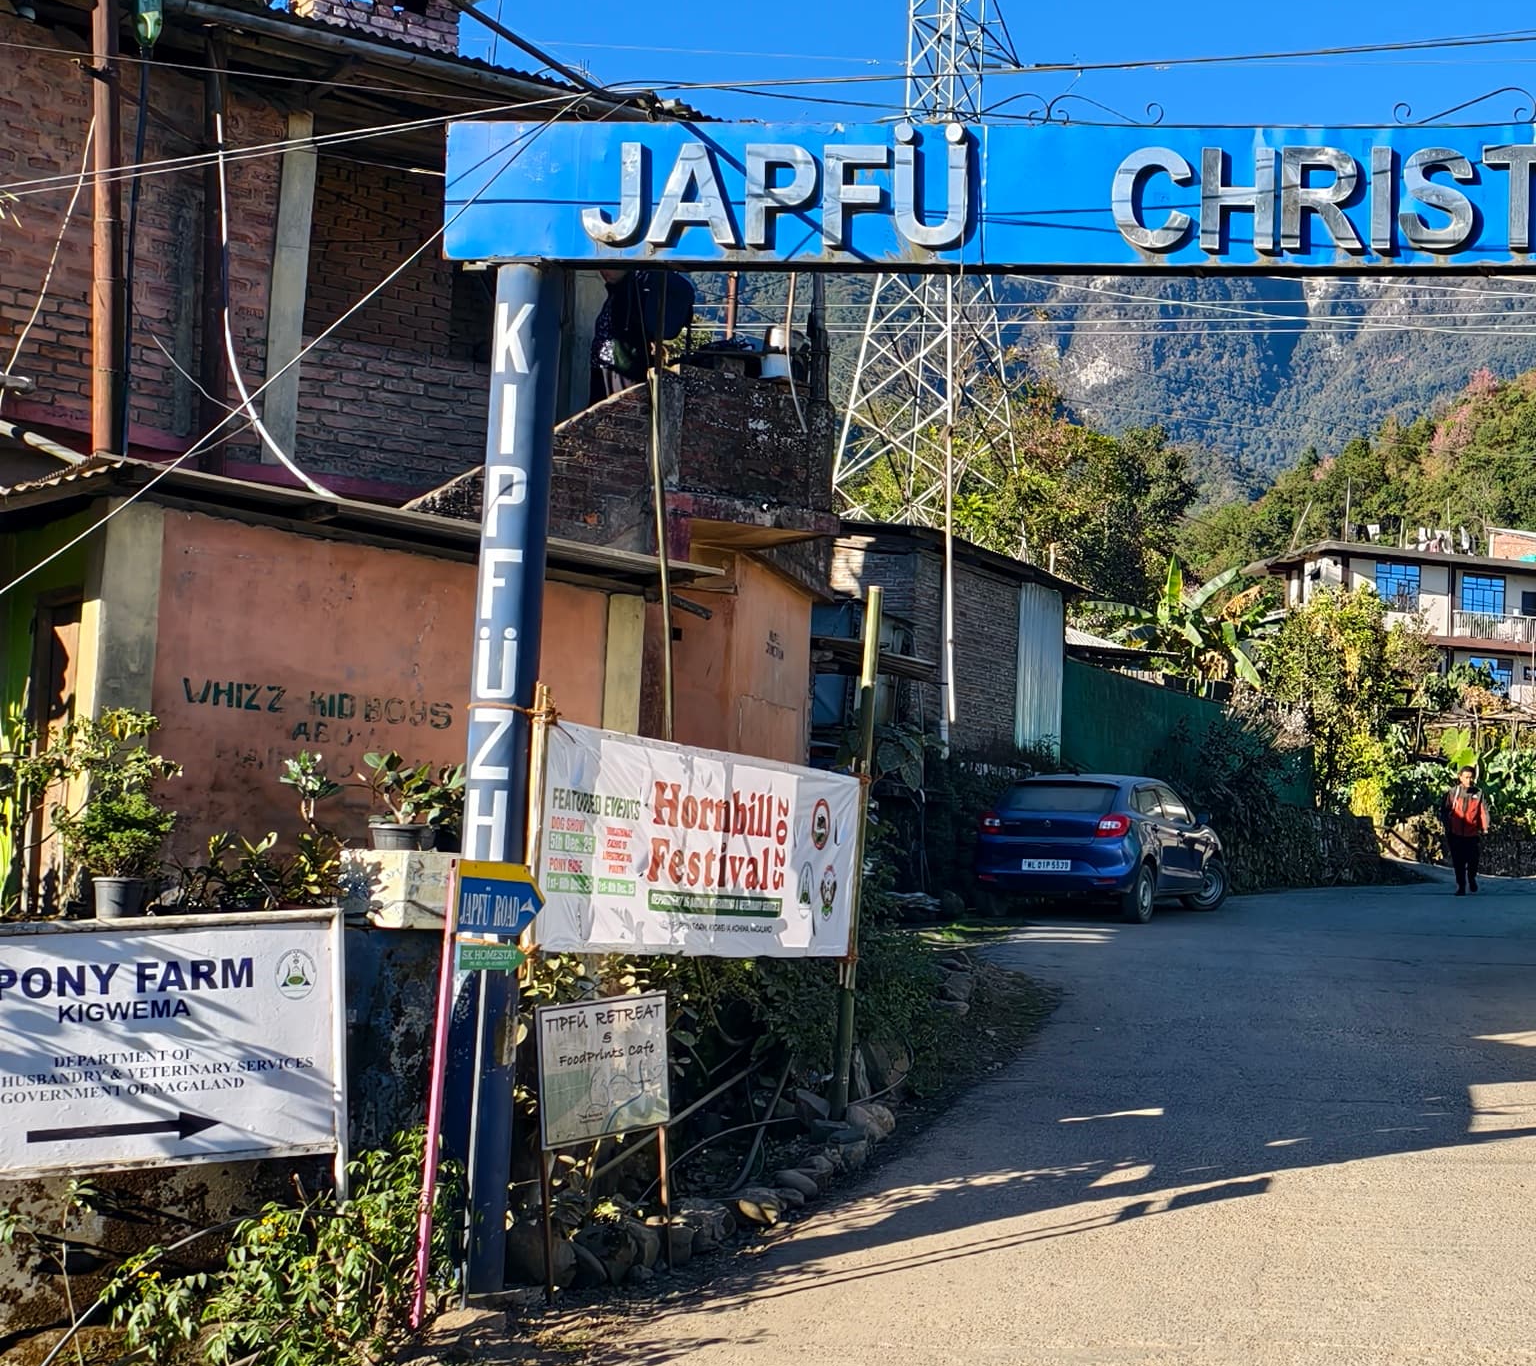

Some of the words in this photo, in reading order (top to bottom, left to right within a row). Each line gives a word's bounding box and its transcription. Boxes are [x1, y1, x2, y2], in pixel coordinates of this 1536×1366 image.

[581, 122, 969, 248] JAPFÜ
[461, 302, 535, 943] KIPFÜZH
[182, 677, 287, 713] WHIZZ
[308, 690, 357, 720] KID
[552, 787, 602, 816] FEATURED
[604, 791, 641, 822] EVENTS
[652, 780, 773, 838] Hornbill
[646, 837, 771, 891] Festival
[773, 798, 790, 891] 2025
[459, 886, 492, 926] JAPFÜ
[493, 895, 520, 928] ROAD
[474, 948, 517, 961] HOMESTAY
[0, 963, 120, 1001] PONY
[136, 957, 255, 994] FARM
[58, 999, 191, 1024] KIGWEMA
[595, 1003, 663, 1028] RETREAT
[2, 1069, 108, 1088] HUSBANDRY
[110, 1068, 122, 1081] &
[128, 1061, 234, 1080] VETERINARY
[237, 1056, 314, 1073] SERVICES
[54, 1050, 169, 1069] DEPARTMENT
[172, 1049, 194, 1061] OF
[0, 1085, 122, 1105] GOVERNMENT
[127, 1083, 150, 1096] OF
[153, 1077, 245, 1095] NAGALAND
